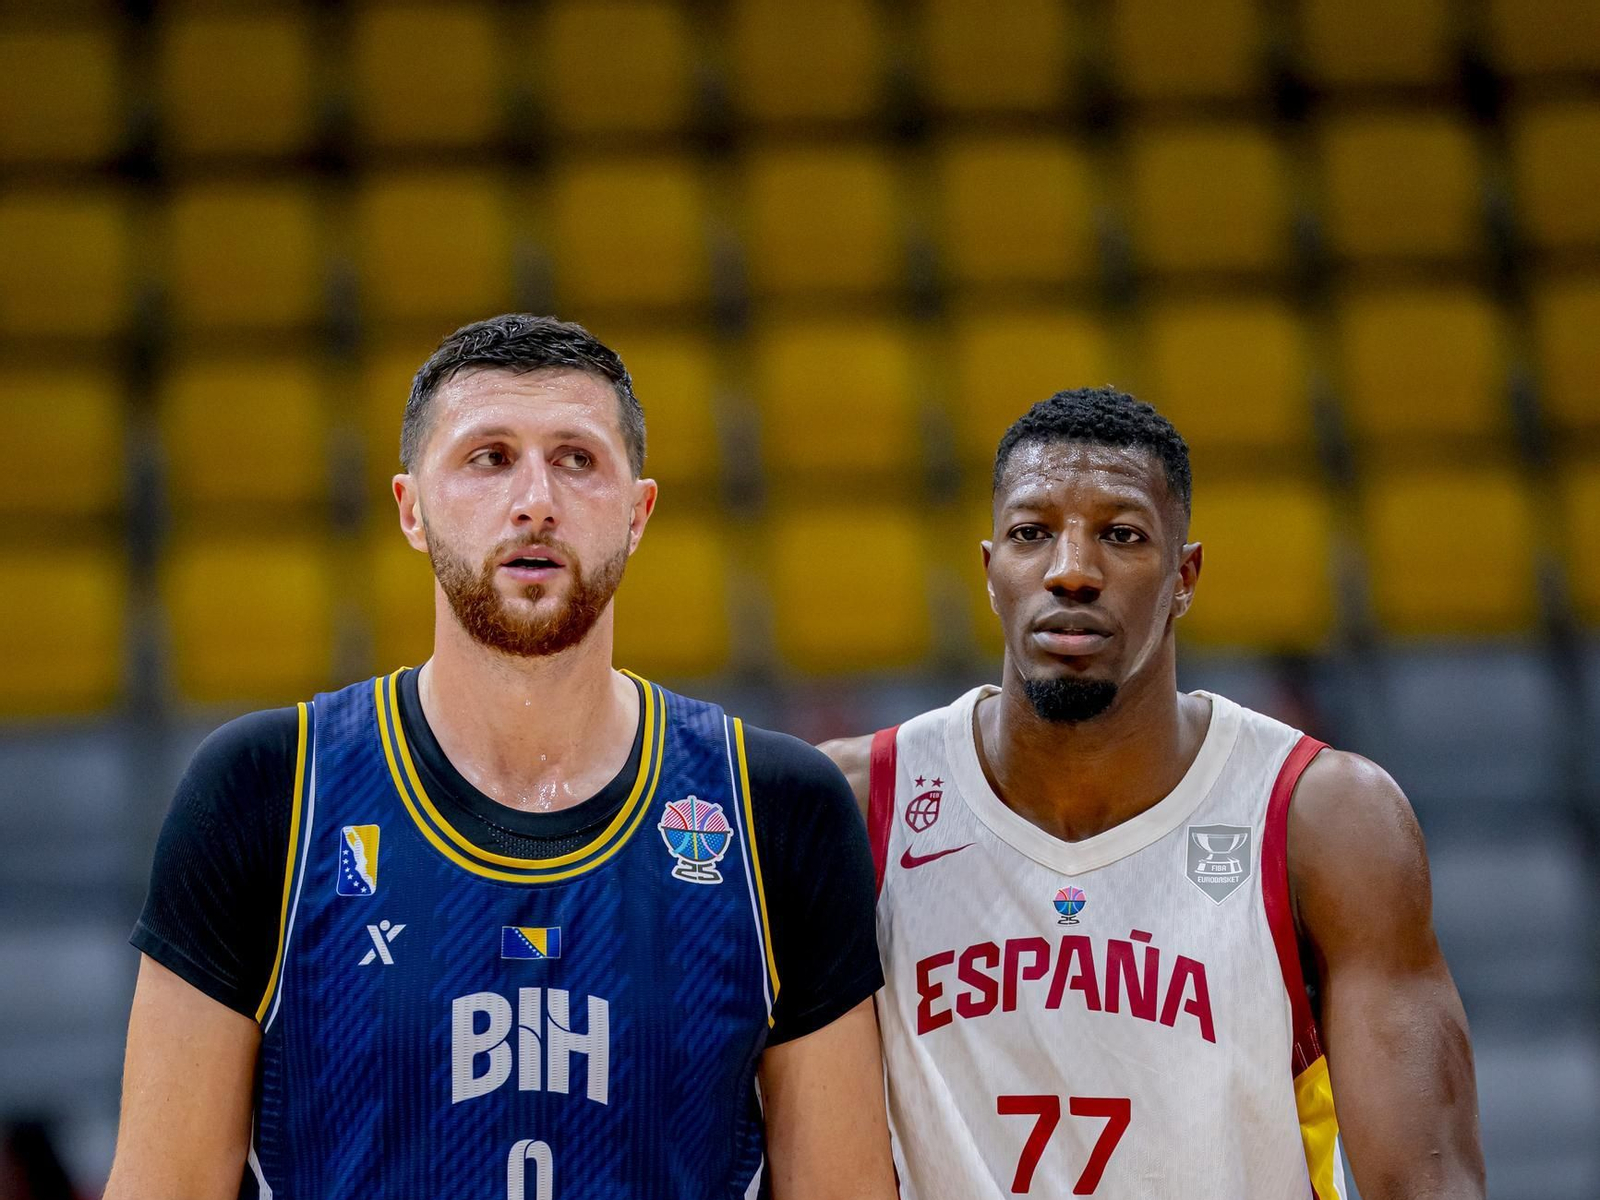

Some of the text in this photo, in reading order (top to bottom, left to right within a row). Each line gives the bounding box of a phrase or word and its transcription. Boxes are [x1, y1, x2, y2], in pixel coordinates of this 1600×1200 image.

[1211, 864, 1227, 872] FIBA
[916, 930, 1216, 1042] ESPAÑA
[451, 987, 610, 1105] BIH
[996, 1094, 1132, 1196] 77
